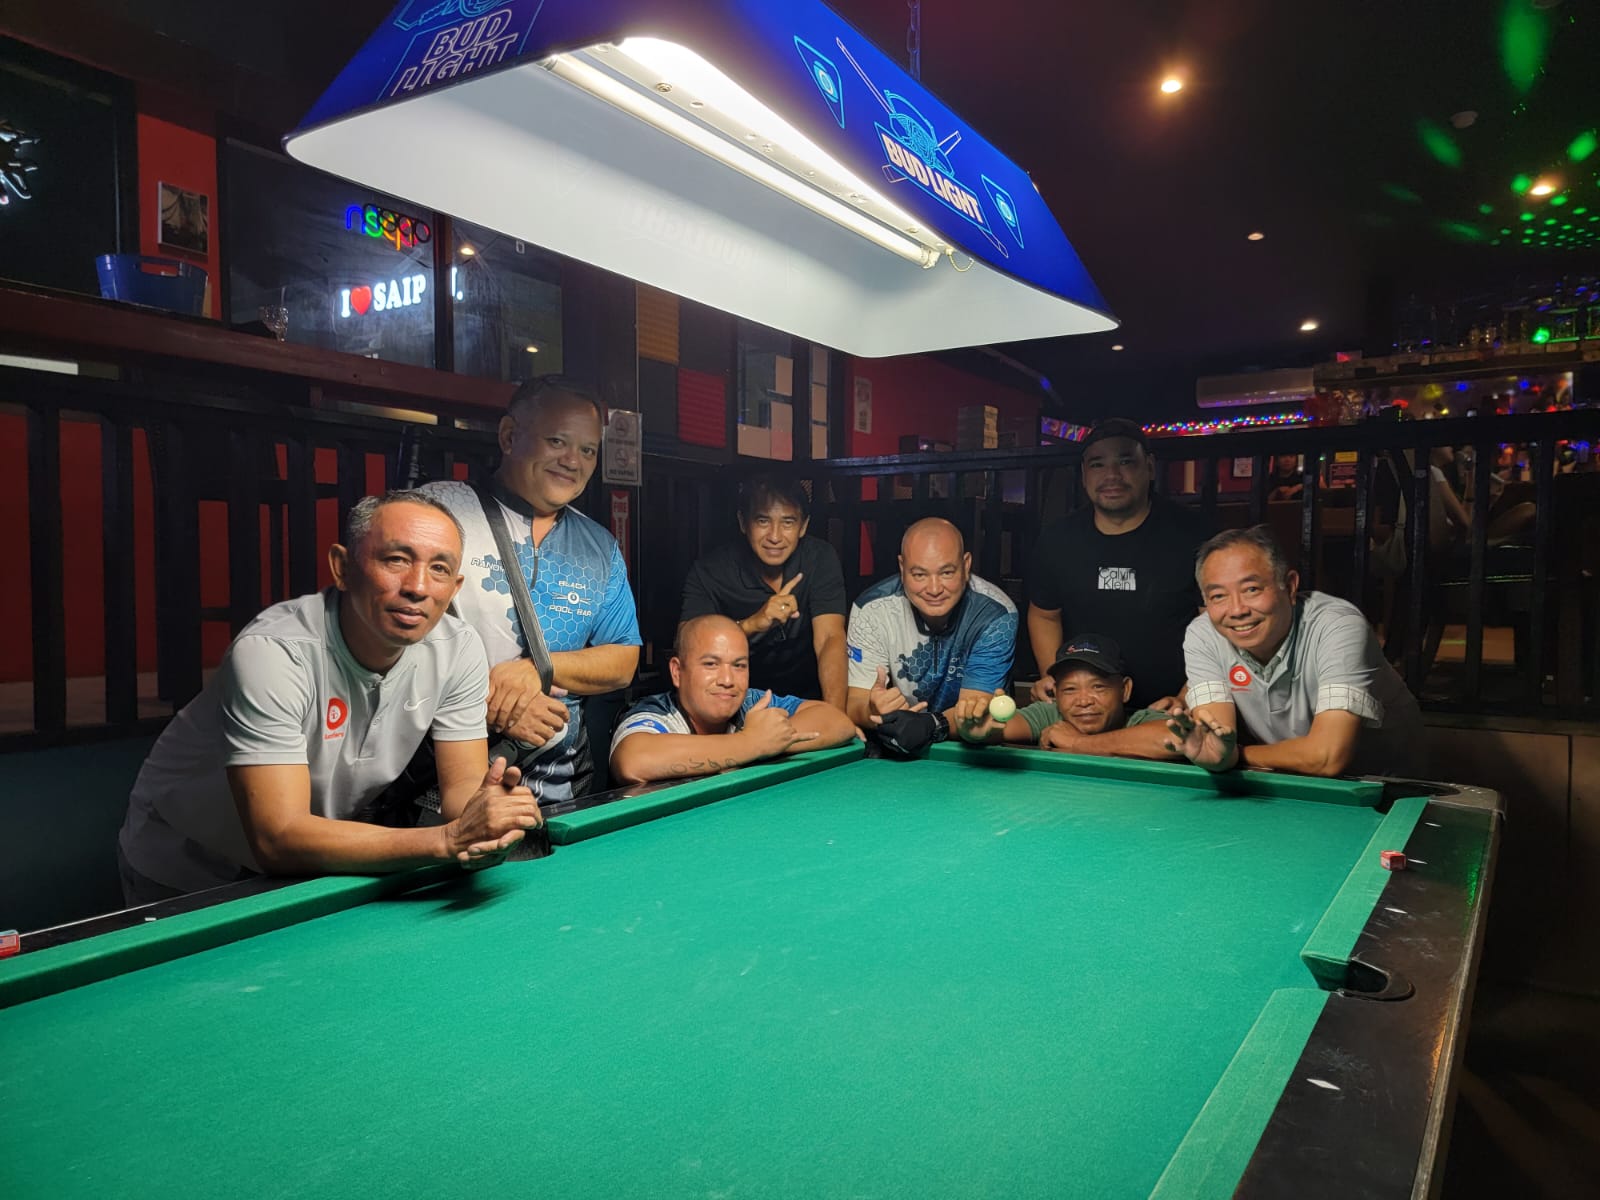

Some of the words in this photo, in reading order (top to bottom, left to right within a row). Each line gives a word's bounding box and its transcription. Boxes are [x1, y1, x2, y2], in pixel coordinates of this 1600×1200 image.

[422, 9, 512, 64] BUD
[390, 32, 519, 97] LIGHT
[881, 133, 930, 187] BUD
[925, 165, 984, 224] LIGHT
[341, 288, 351, 318] I
[549, 604, 574, 614] POOL
[576, 608, 592, 617] BAR
